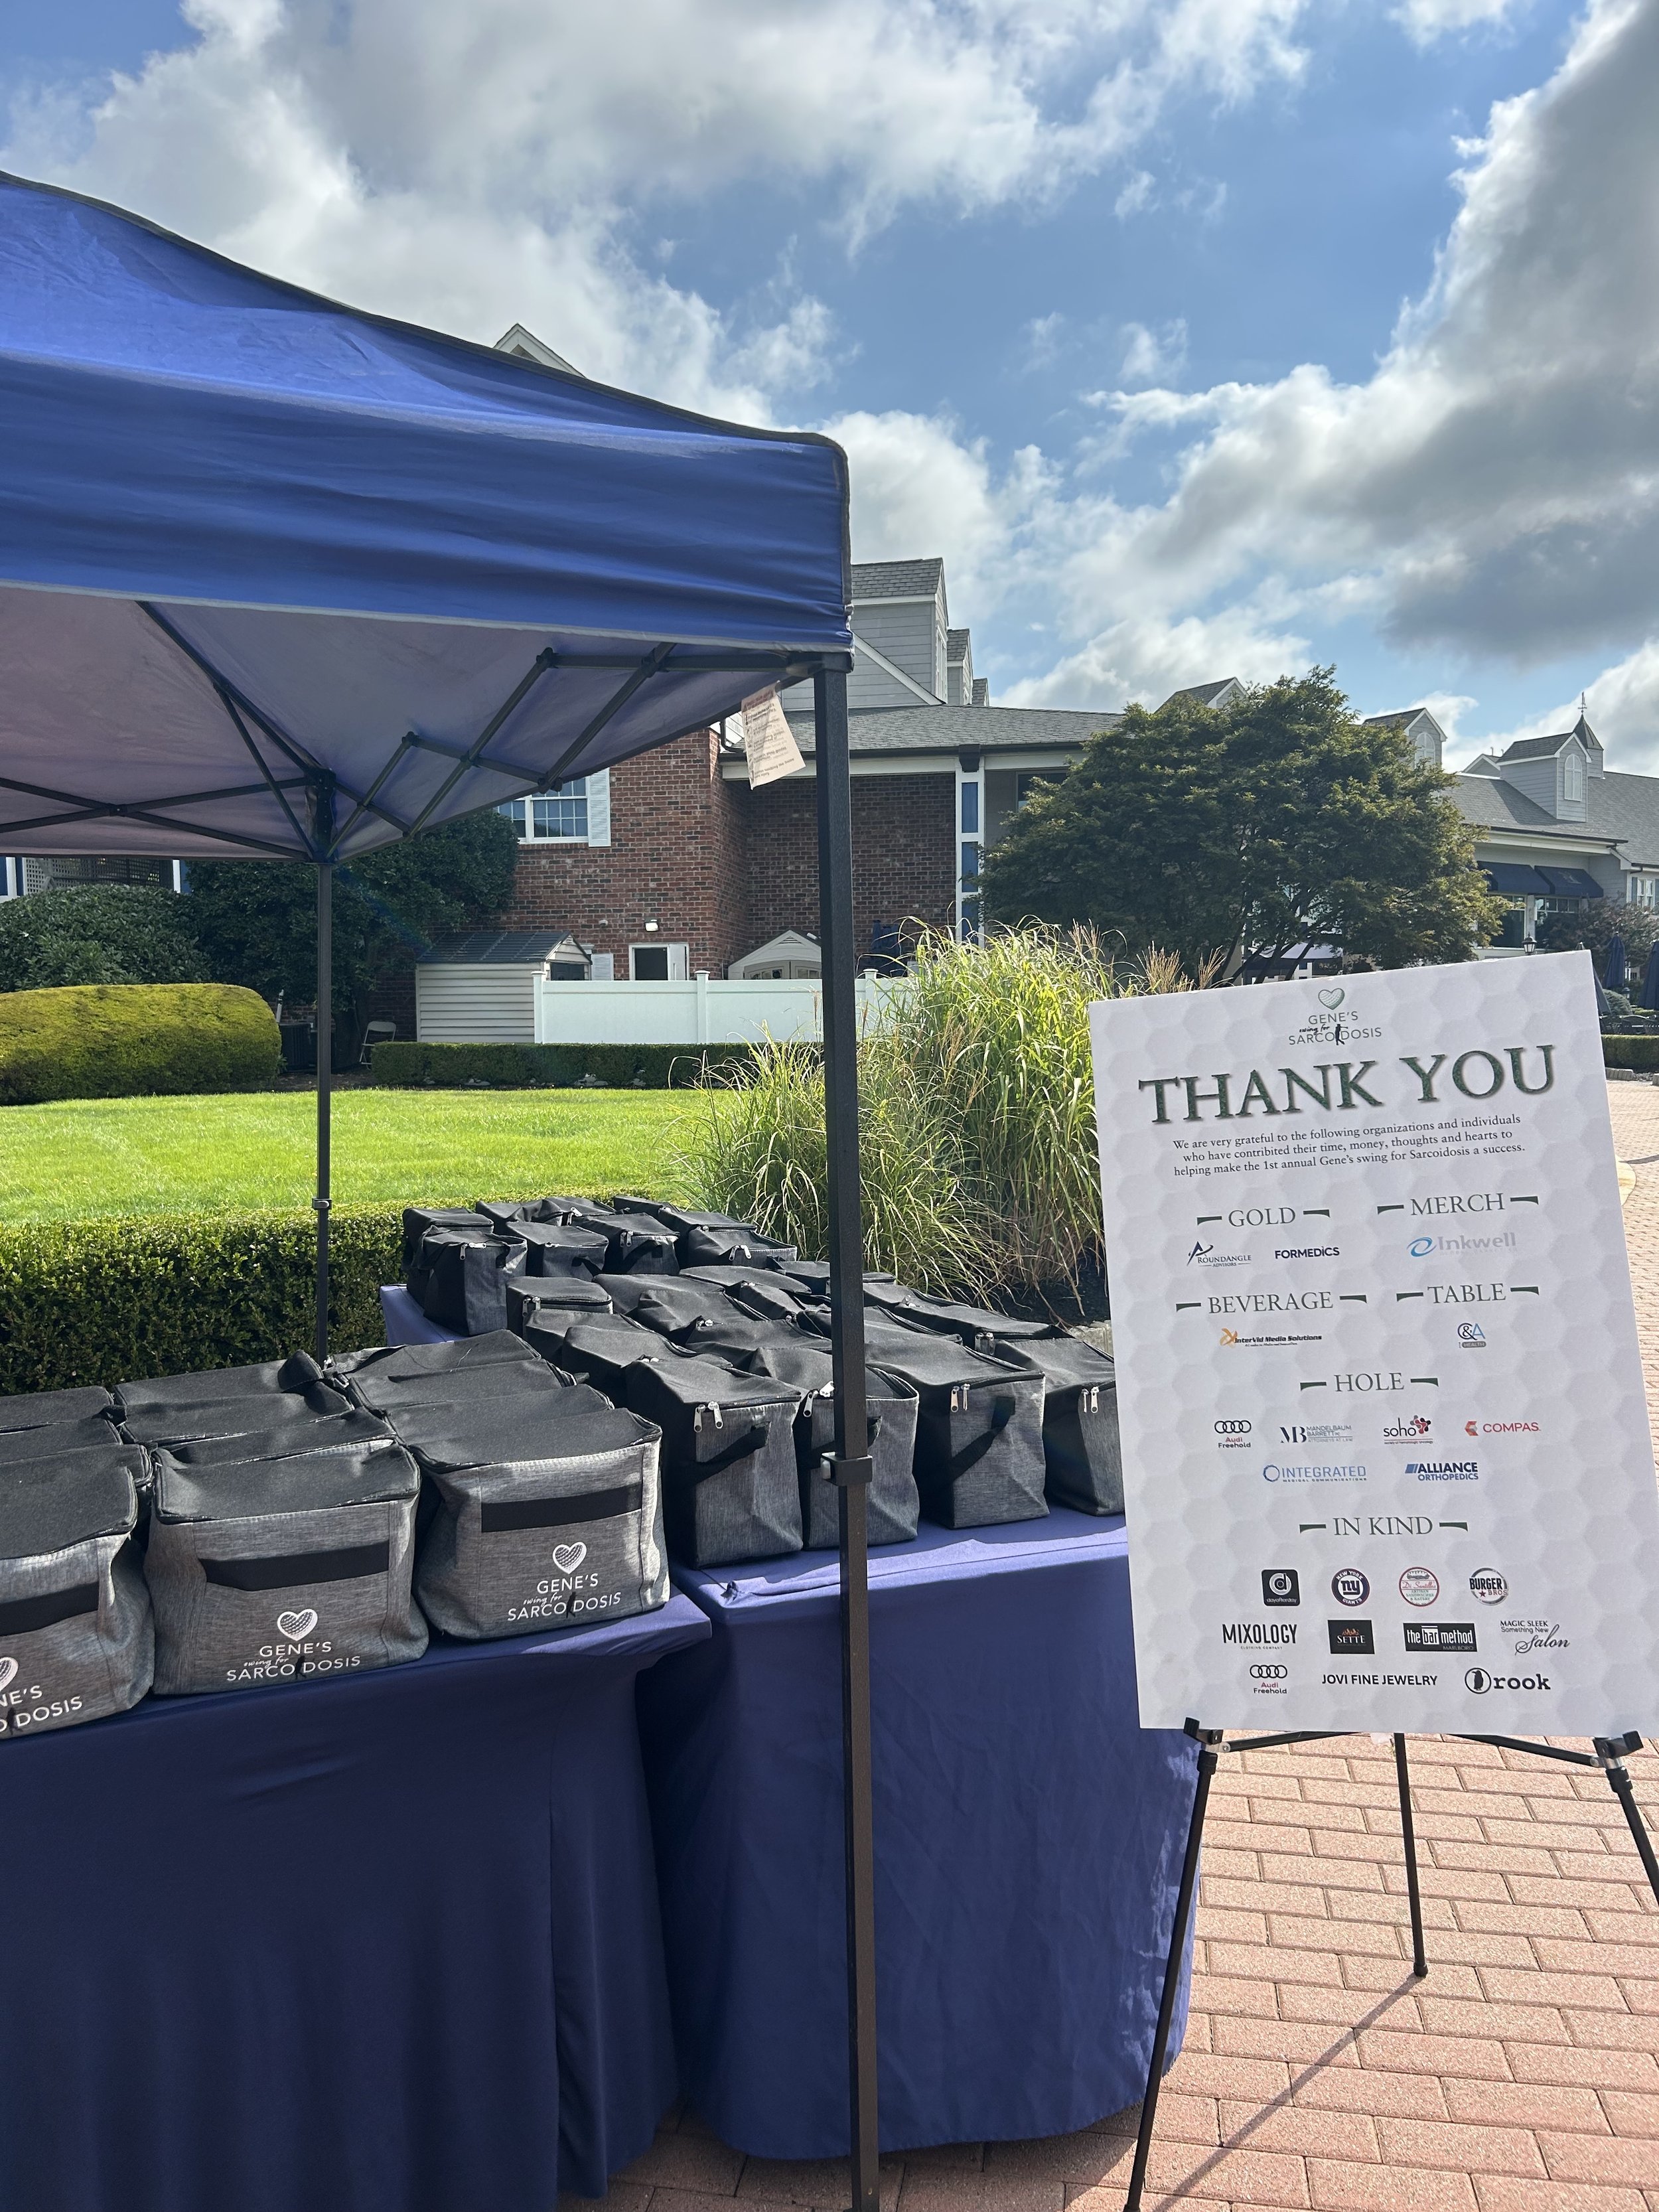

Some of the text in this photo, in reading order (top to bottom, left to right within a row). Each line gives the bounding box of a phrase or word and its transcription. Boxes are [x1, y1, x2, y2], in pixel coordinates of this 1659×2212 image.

[1308, 1011, 1358, 1025] GENE'S
[1320, 1023, 1331, 1033] for
[1138, 1044, 1554, 1124] THANK YOU
[1173, 1140, 1189, 1149] We
[1210, 1138, 1232, 1148] very
[1234, 1133, 1274, 1147] grateful
[1291, 1131, 1307, 1140] the
[1310, 1128, 1360, 1140] following
[1362, 1122, 1435, 1137] organizations
[1437, 1118, 1458, 1130] and
[1461, 1114, 1521, 1128] individuals
[1183, 1130, 1513, 1162] who have contribited their time, money, thoughts and hearts to
[1174, 1163, 1211, 1177] helping
[1214, 1162, 1241, 1174] make
[1244, 1160, 1260, 1171] the
[1263, 1161, 1278, 1170] 1st
[1281, 1157, 1317, 1169] annual
[1319, 1155, 1354, 1166] Gene's
[1356, 1153, 1388, 1164] swing
[1390, 1149, 1407, 1161] for
[1409, 1147, 1471, 1160] Sarcoidosis
[1482, 1143, 1526, 1155] success.
[1410, 1193, 1506, 1216] MERCH
[1228, 1207, 1296, 1227] GOLD
[1437, 1232, 1516, 1251] Inkwell
[1208, 1291, 1334, 1314] BEVERAGE
[1427, 1283, 1507, 1304] TABLE
[1334, 1372, 1405, 1392] HOLE
[1383, 1417, 1417, 1437] soho
[1482, 1422, 1540, 1433] COMPAS
[1281, 1465, 1366, 1479] INTEGRATED
[1417, 1461, 1478, 1474] ALLIANCE
[1417, 1472, 1479, 1481] ORTHOPEDICS
[1333, 1516, 1433, 1536] IN KIND
[536, 1573, 599, 1594] GENE'S
[1336, 1570, 1363, 1580] NEW YORK
[1469, 1578, 1503, 1591] BURGER
[550, 1591, 563, 1603] for
[1222, 1623, 1297, 1644] MIXOLOGY
[1406, 1628, 1474, 1644] the bar method
[1514, 1623, 1571, 1656] Salon
[259, 1641, 332, 1658] GENE'S
[275, 1655, 289, 1666] for
[1322, 1674, 1438, 1686] JOVI FINE JEWELRY
[1493, 1673, 1551, 1690] rook
